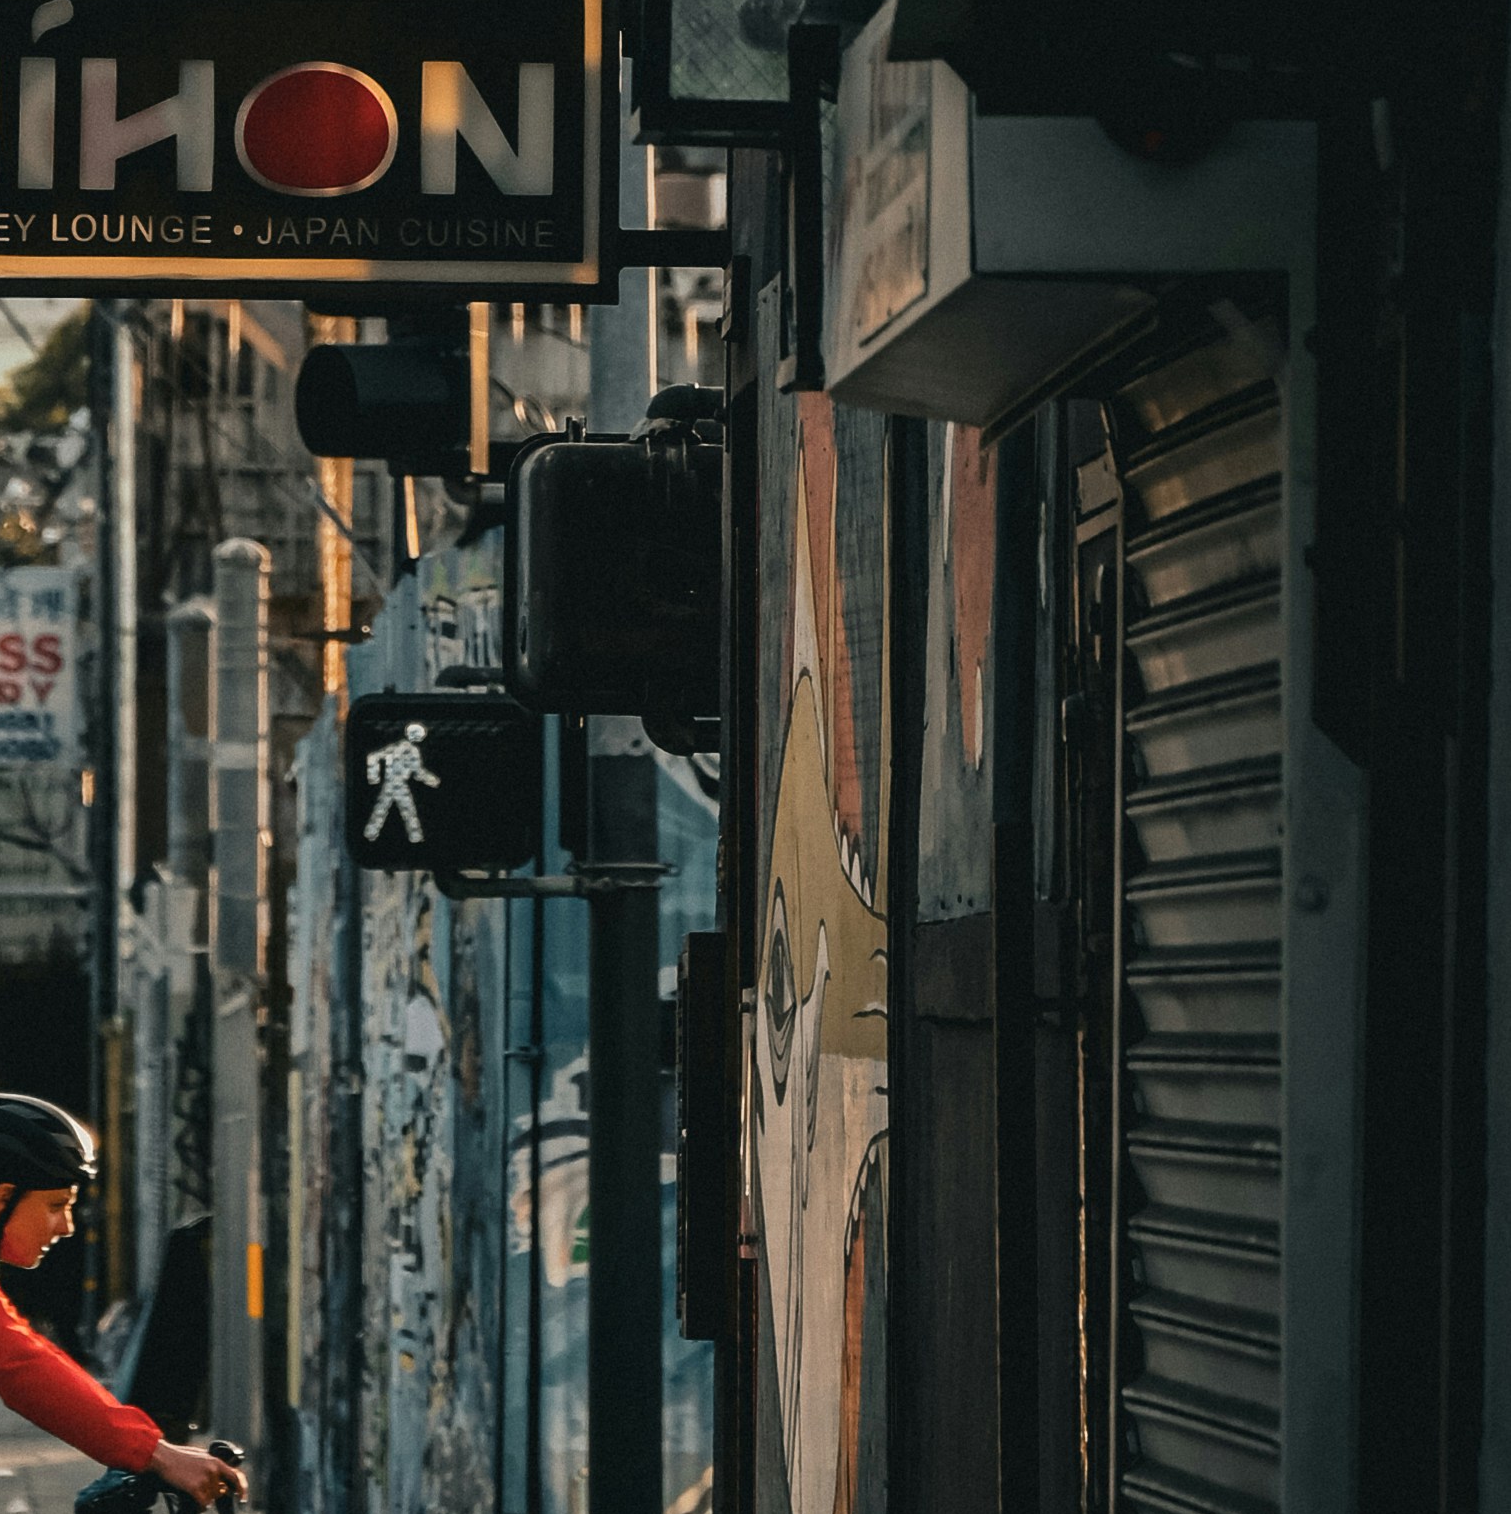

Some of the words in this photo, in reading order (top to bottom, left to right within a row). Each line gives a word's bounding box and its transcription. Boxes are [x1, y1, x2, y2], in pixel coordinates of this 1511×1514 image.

[51, 213, 212, 244] LOUNGE
[257, 216, 379, 247] JAPAN
[399, 218, 555, 248] CUISINE
